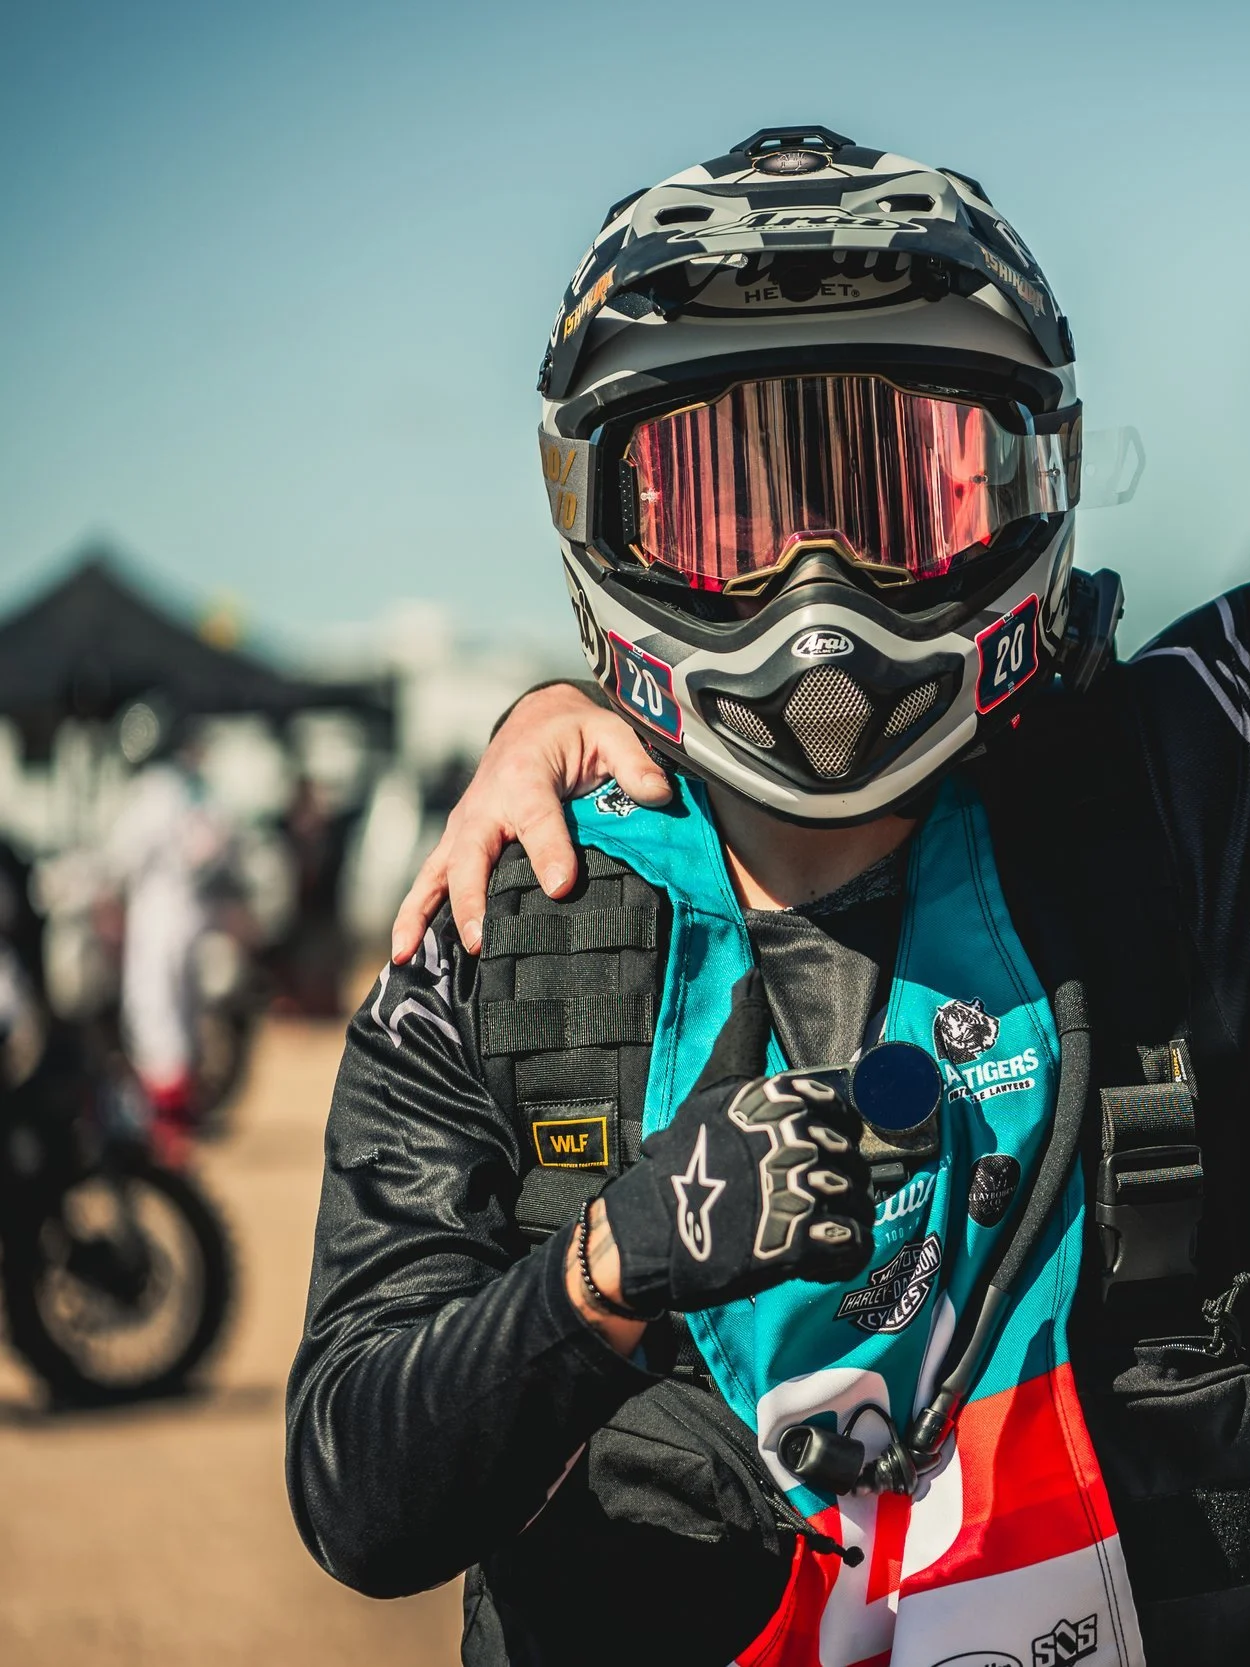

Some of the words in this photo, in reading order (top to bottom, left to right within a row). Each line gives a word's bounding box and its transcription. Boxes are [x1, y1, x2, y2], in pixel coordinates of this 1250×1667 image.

[744, 283, 854, 303] HEET
[797, 633, 848, 653] Arai
[994, 623, 1026, 687] 20
[626, 657, 663, 717] 20
[962, 1047, 1040, 1090] TIGERS
[990, 1080, 1030, 1097] LAWYERS
[550, 1134, 588, 1153] WLF
[885, 1227, 904, 1244] 100
